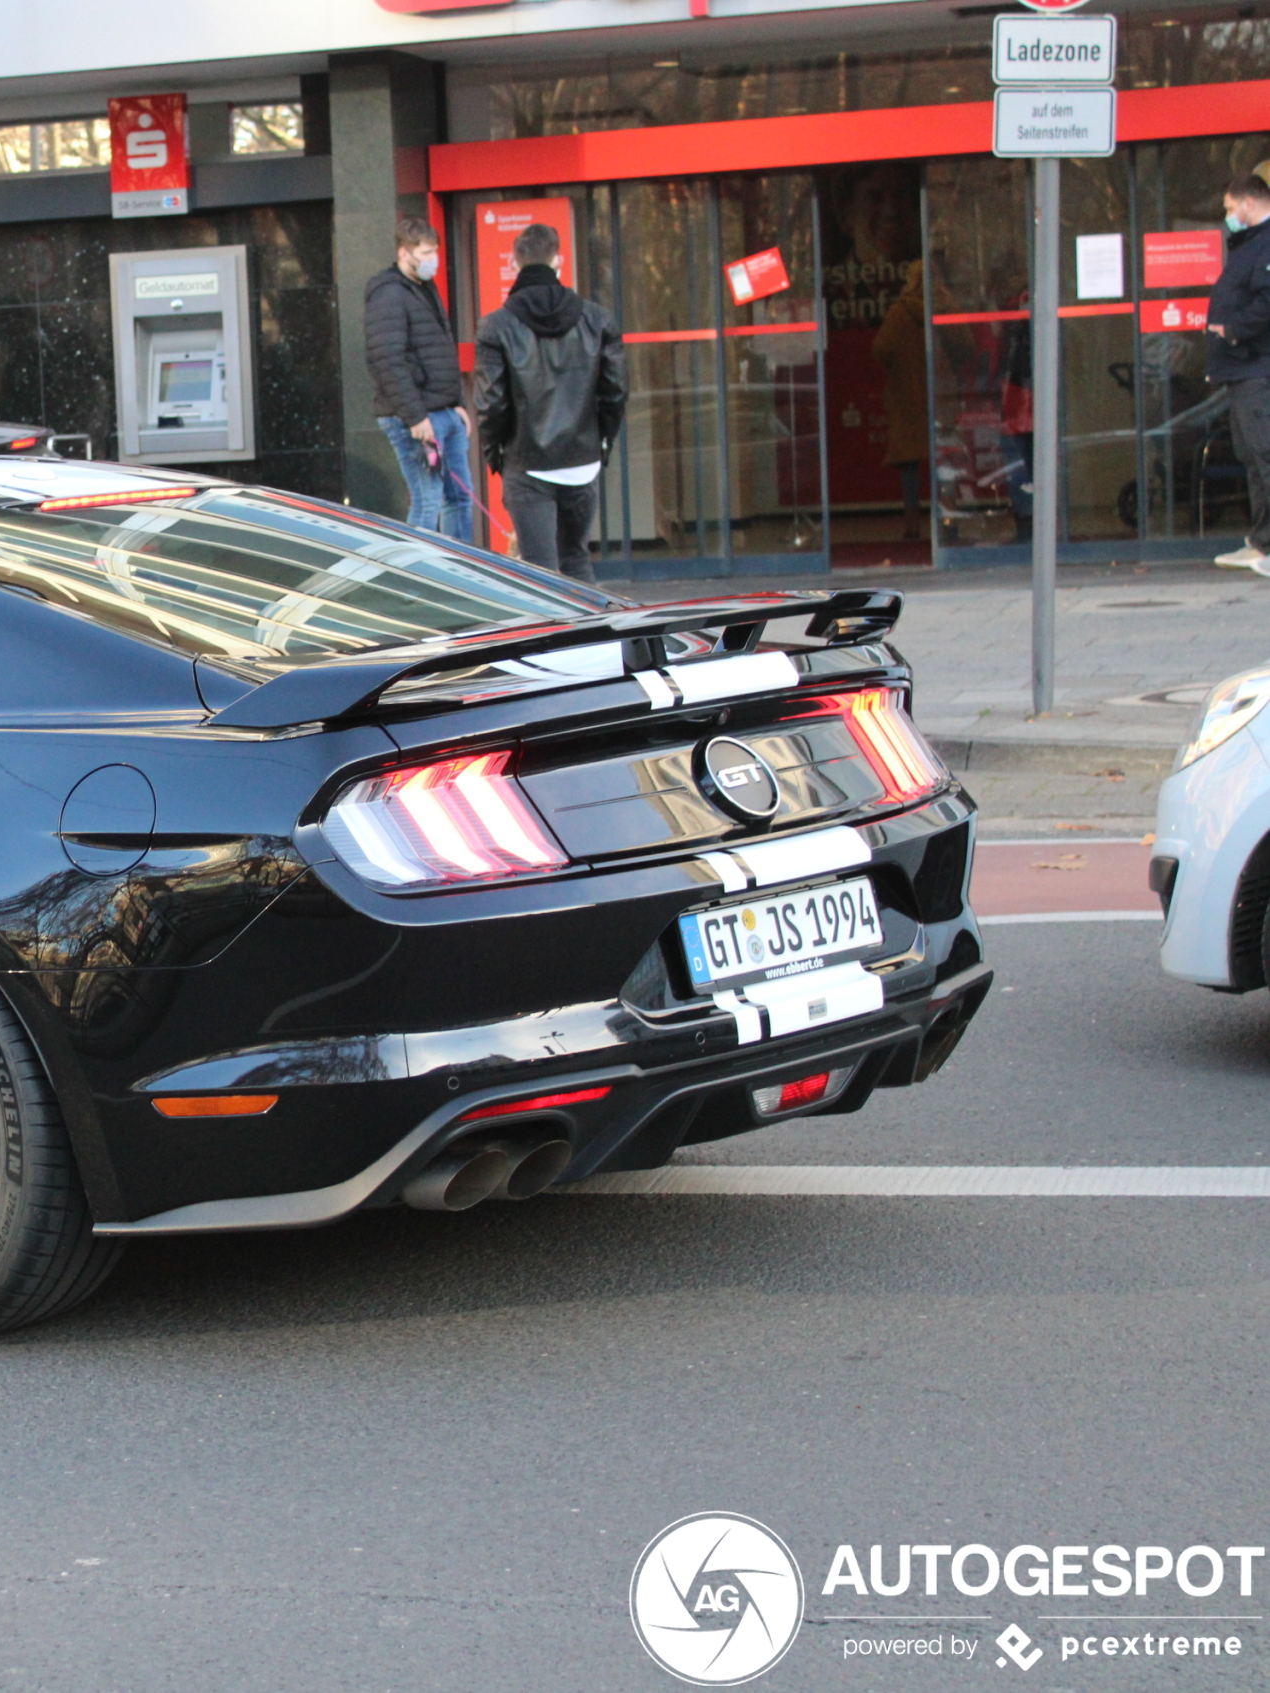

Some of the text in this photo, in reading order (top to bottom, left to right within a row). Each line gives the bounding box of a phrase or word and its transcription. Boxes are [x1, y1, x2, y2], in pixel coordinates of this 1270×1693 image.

[1007, 37, 1101, 62] Ladezone
[1031, 103, 1073, 118] auf dem
[1017, 124, 1088, 140] Seitenstreifen
[138, 280, 215, 295] Geldautomat
[717, 763, 761, 788] GT
[704, 887, 876, 969] GT JS 1994
[693, 957, 703, 972] D
[765, 957, 824, 980] www.ebbert.de
